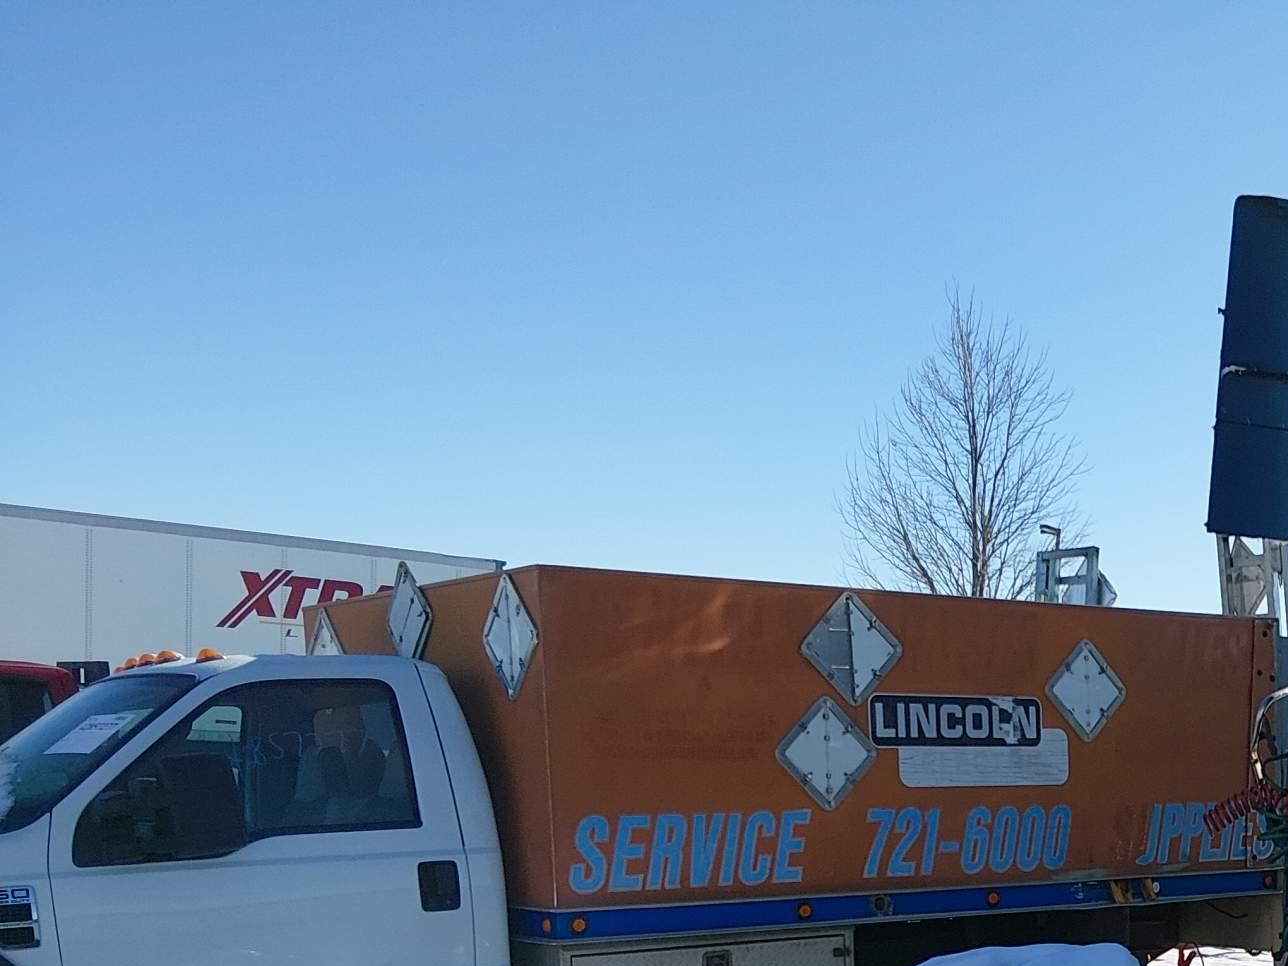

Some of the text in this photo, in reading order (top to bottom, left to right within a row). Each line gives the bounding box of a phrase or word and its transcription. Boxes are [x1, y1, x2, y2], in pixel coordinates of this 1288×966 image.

[874, 702, 1037, 740] LINCOLN
[568, 808, 812, 894] SERVICE
[863, 804, 1072, 878] 721-6000
